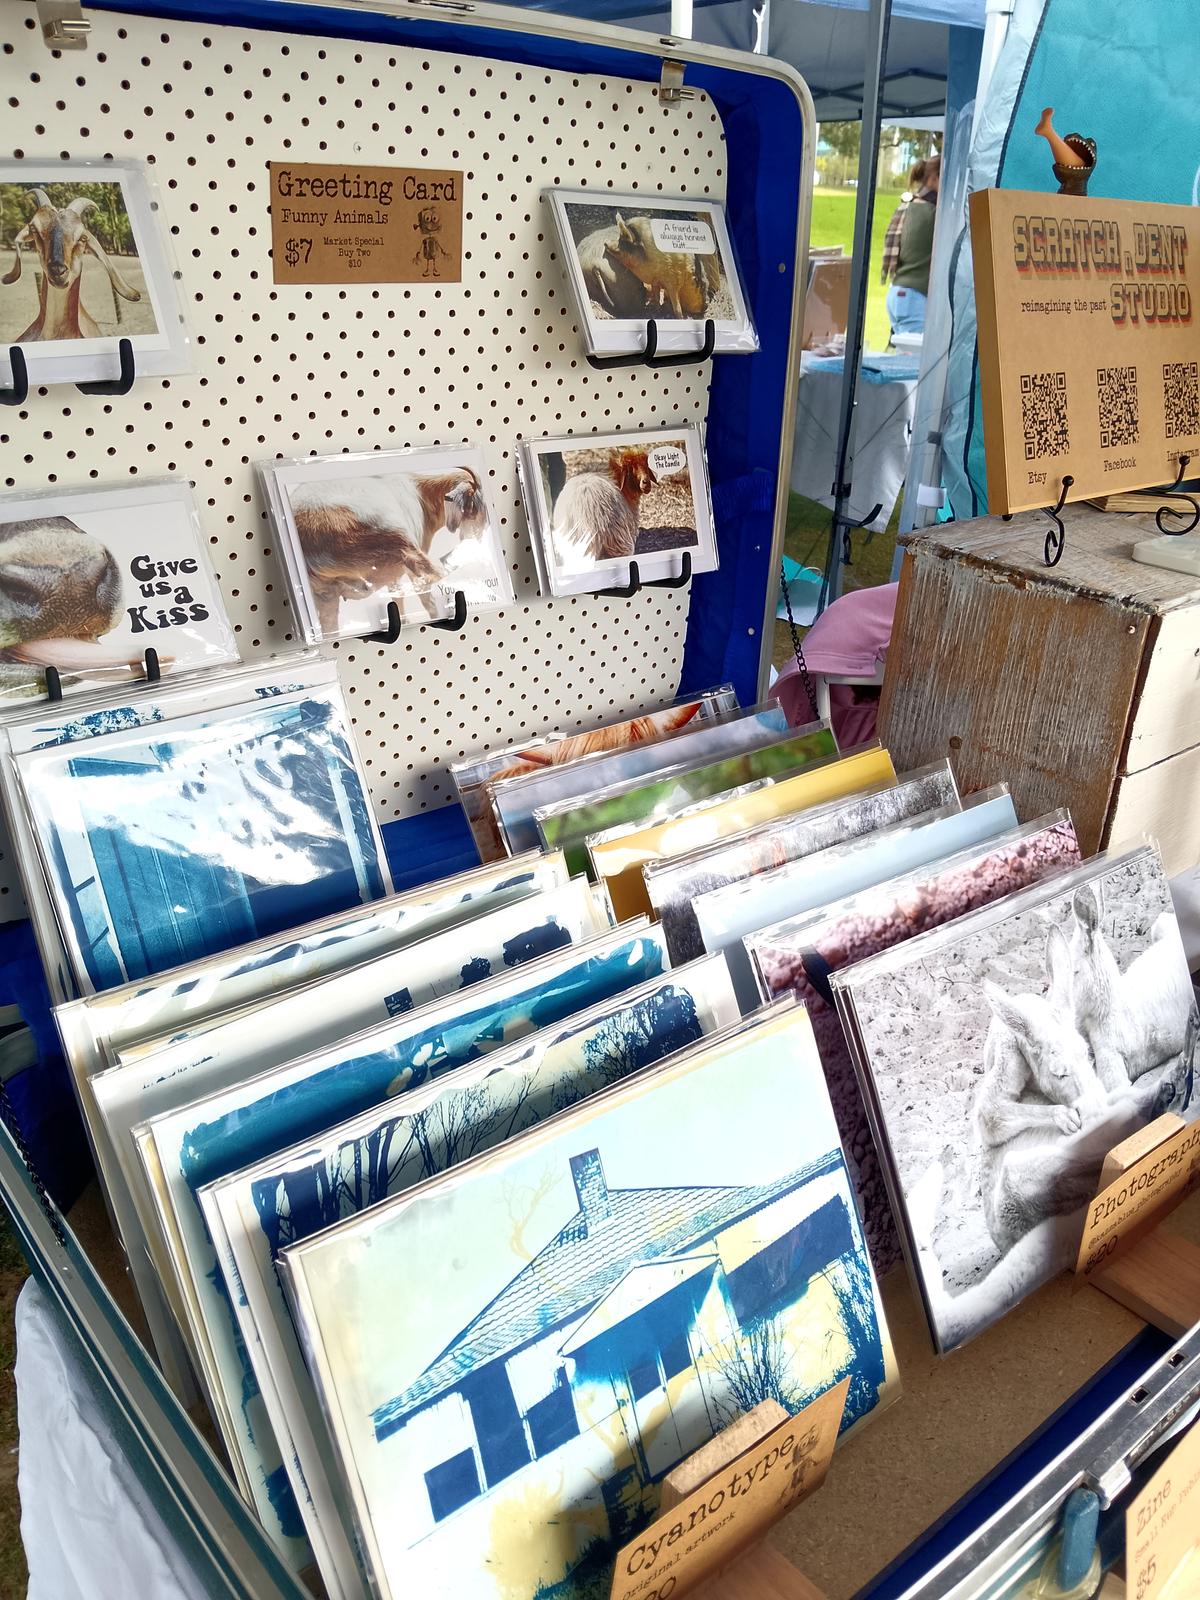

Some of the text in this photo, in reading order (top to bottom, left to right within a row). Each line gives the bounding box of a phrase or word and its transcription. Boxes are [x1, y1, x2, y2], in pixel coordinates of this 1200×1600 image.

[278, 171, 456, 205] Greeting Card
[281, 208, 389, 226] Funny Animals
[285, 238, 313, 267] $7
[323, 237, 385, 247] Market Special
[338, 248, 371, 257] Buy Two
[1013, 215, 1122, 275] SCRATCH
[1133, 223, 1189, 277] DENT
[348, 259, 362, 268] $10
[1021, 299, 1107, 315] reimagining the past
[1110, 283, 1193, 325] STUDIO
[1027, 471, 1048, 485] Etsy
[1103, 457, 1137, 472] Facebook
[130, 554, 199, 582] Give
[139, 580, 194, 604] us a
[127, 603, 210, 634] Kiss
[1090, 1128, 1200, 1229] Photograph
[626, 1433, 795, 1576] Cyanotype
[1136, 1479, 1171, 1536] Zine
[622, 1511, 737, 1600] Original artwork
